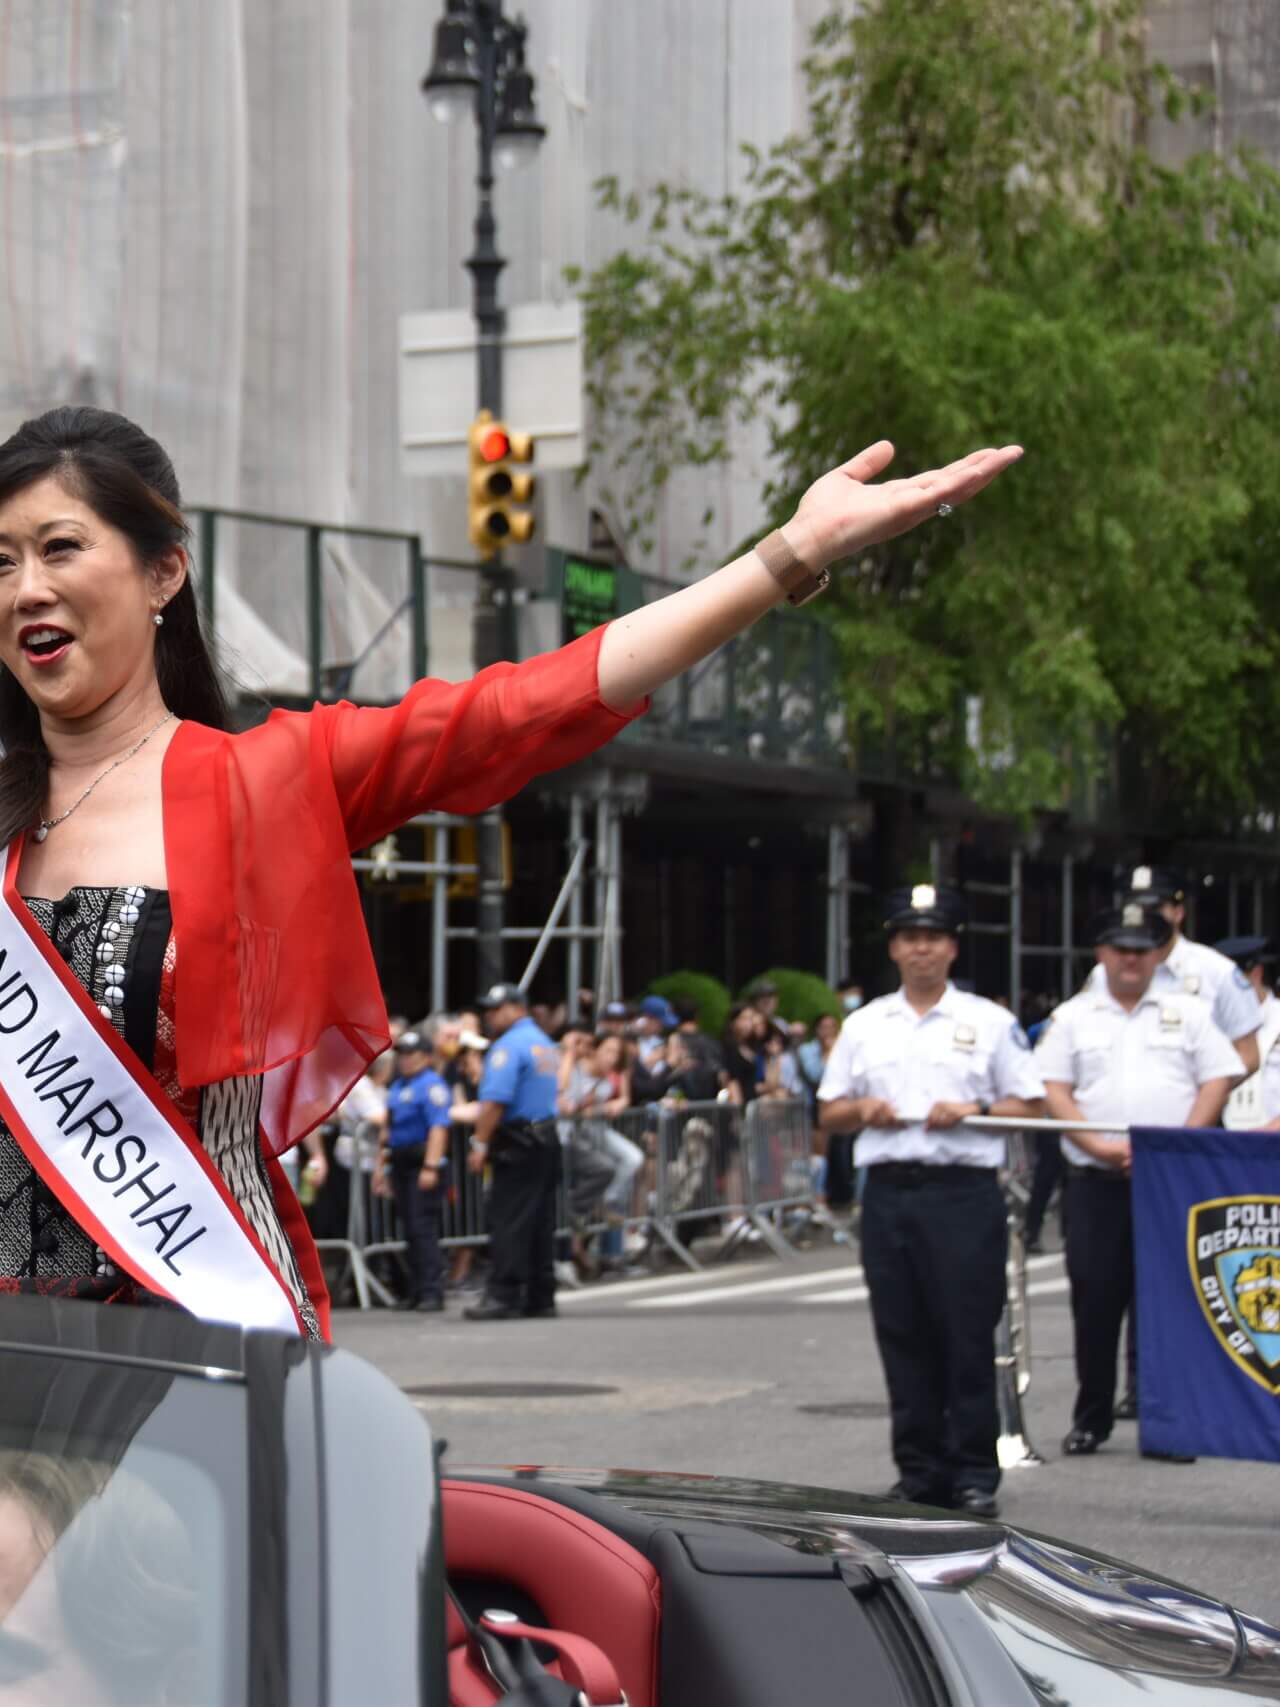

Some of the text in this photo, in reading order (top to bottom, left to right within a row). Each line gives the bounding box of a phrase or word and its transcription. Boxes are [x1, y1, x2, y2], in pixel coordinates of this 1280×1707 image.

[16, 1029, 208, 1278] MARSHAL
[1225, 1203, 1280, 1228] POLI
[1200, 1275, 1256, 1355] CITY OF
